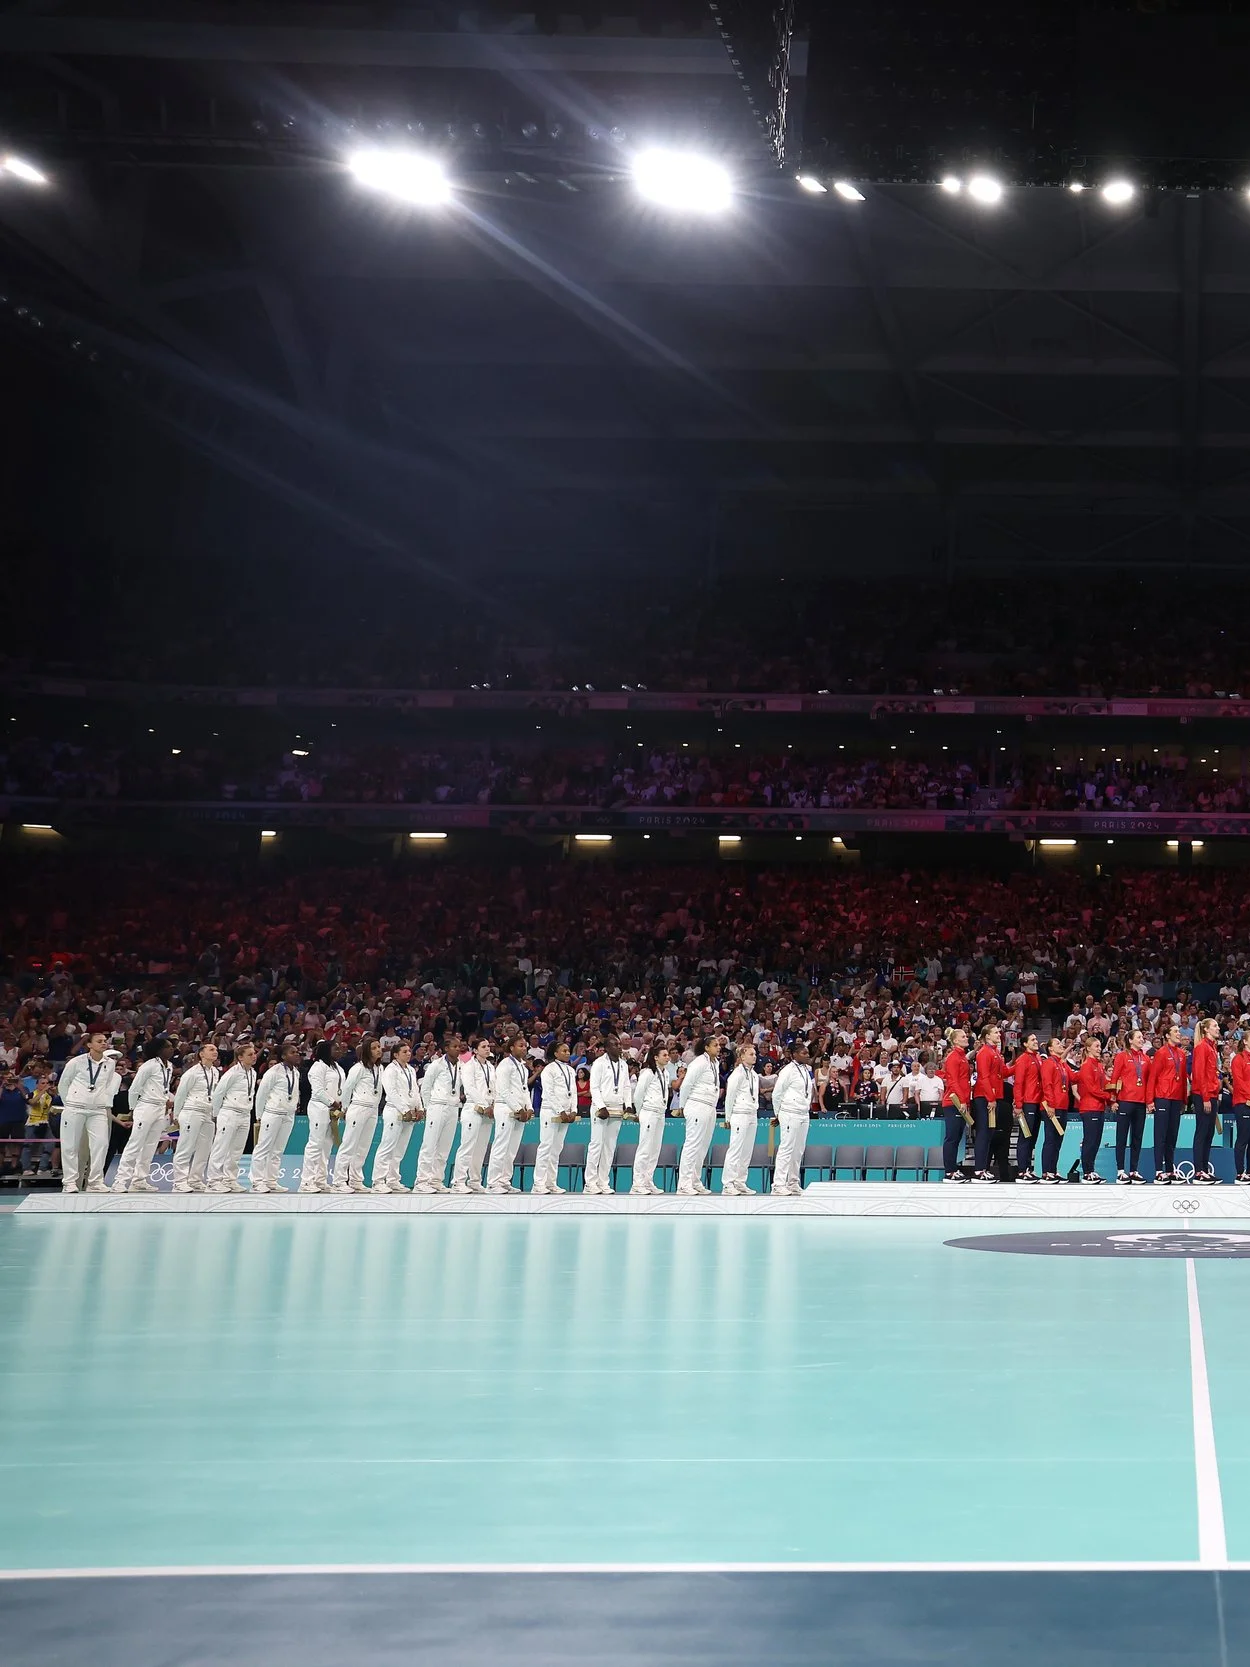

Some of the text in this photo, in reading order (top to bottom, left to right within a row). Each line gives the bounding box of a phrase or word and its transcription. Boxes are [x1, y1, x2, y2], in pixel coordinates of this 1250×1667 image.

[639, 816, 706, 824] PARIS 2024
[1094, 821, 1160, 829] PARIS 2024
